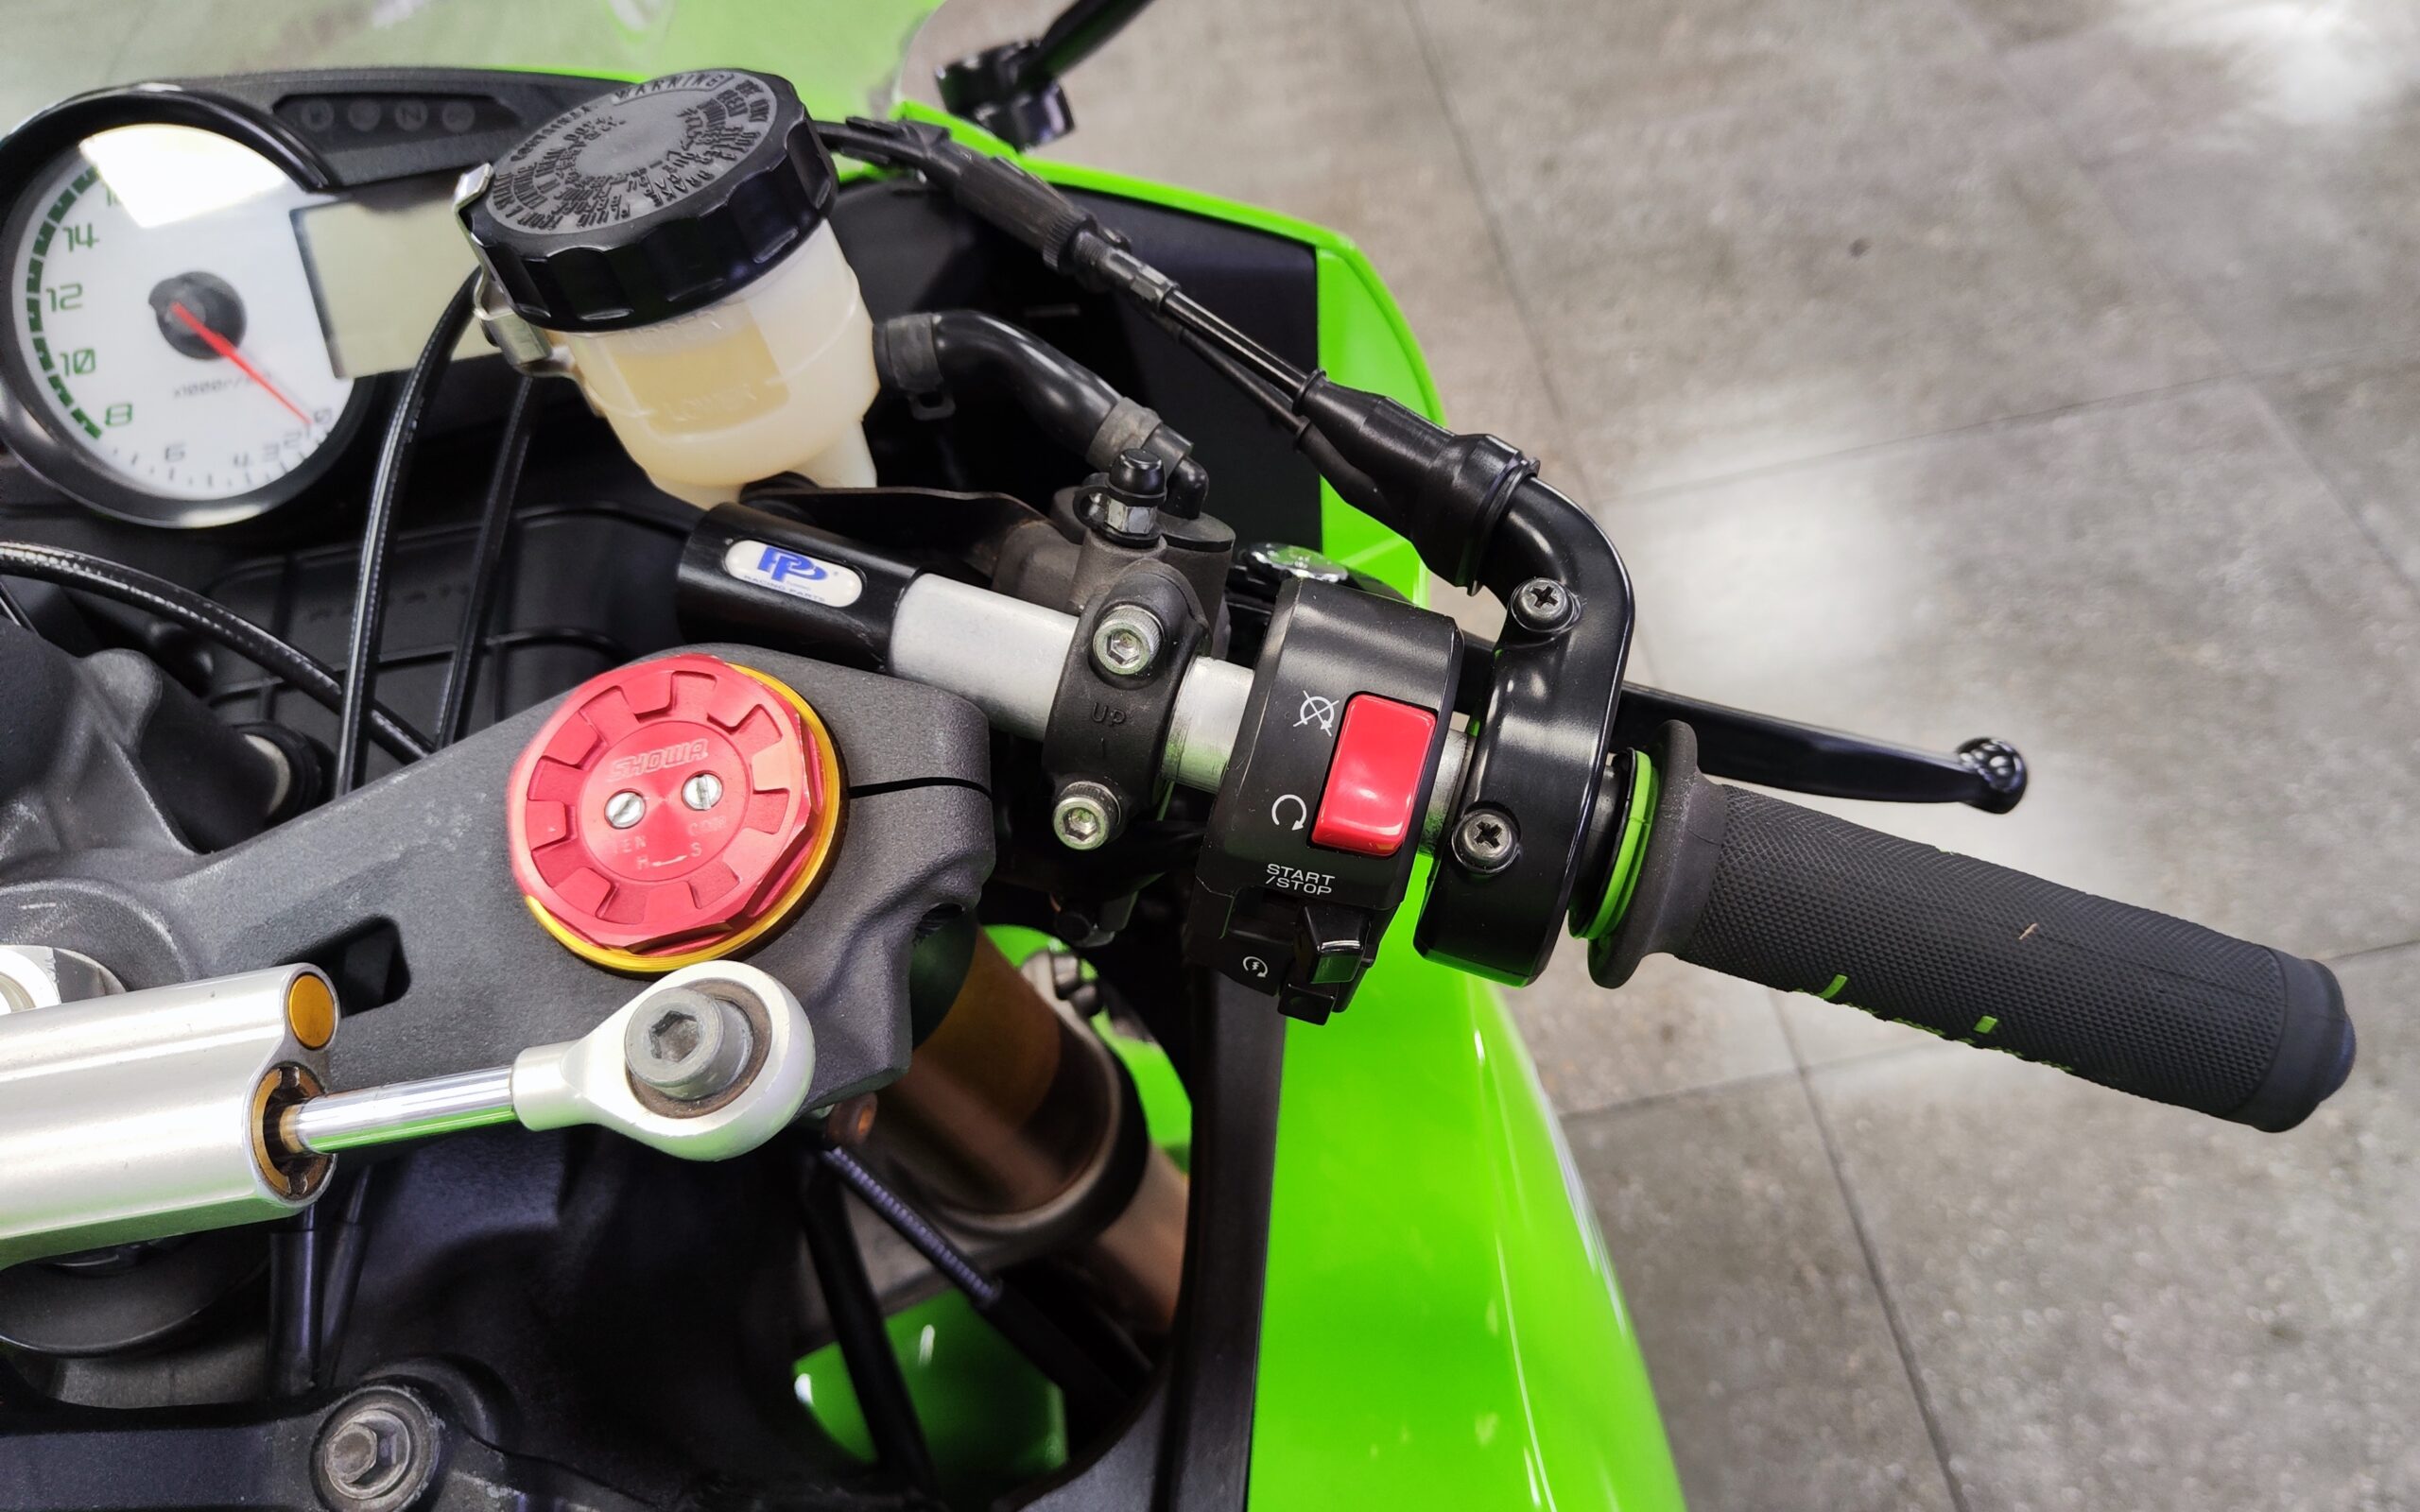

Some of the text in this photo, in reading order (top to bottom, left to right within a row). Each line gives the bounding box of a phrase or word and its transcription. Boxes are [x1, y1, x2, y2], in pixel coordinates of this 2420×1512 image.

[615, 74, 725, 100] WARNING
[62, 222, 99, 253] 14
[45, 283, 83, 312] 12
[60, 348, 96, 377] 10
[104, 403, 133, 427] 8
[284, 430, 302, 449] 2
[164, 443, 186, 462] 6
[233, 454, 253, 469] 4
[262, 443, 281, 462] 3
[1092, 702, 1127, 728] UP
[608, 738, 709, 782] SHOWA
[1265, 875, 1332, 896] /STOP
[1267, 863, 1336, 886] START
